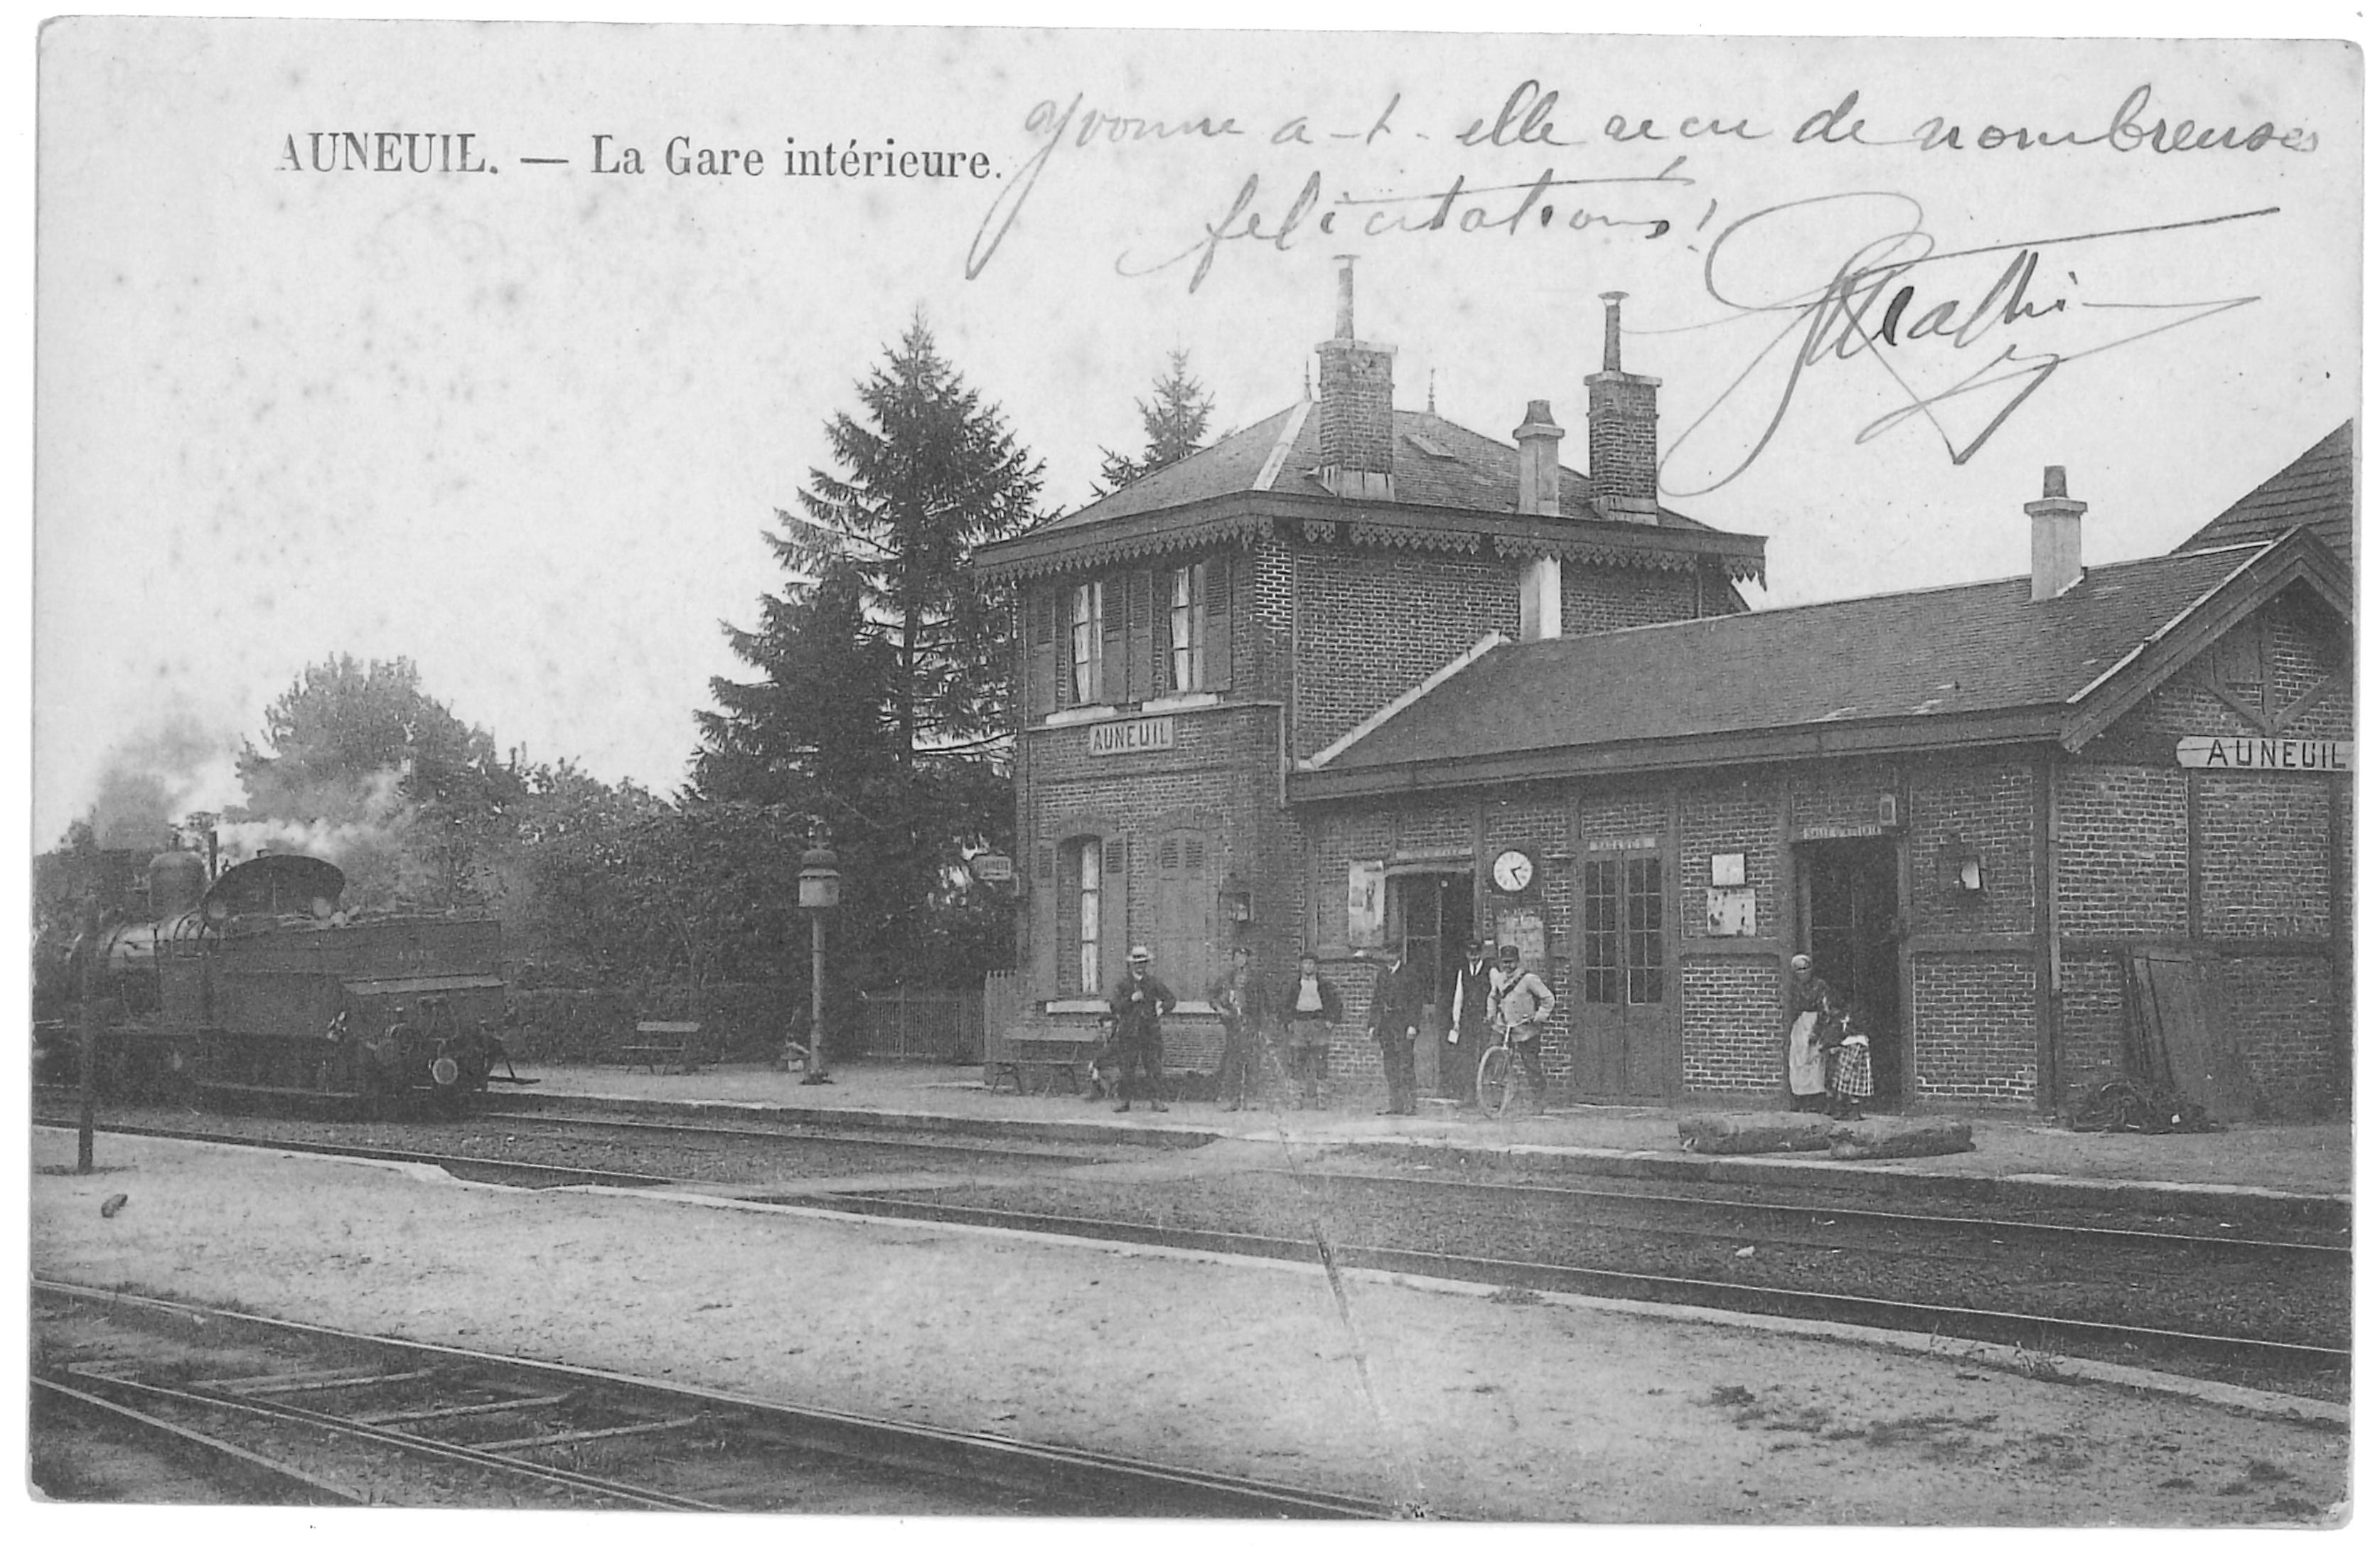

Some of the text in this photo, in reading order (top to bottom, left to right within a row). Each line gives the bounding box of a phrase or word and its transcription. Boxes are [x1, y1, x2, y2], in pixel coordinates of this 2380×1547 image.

[1791, 90, 1880, 145] de
[1093, 722, 1169, 751] AUNEUIL
[2206, 738, 2347, 769] AUNEUIL
